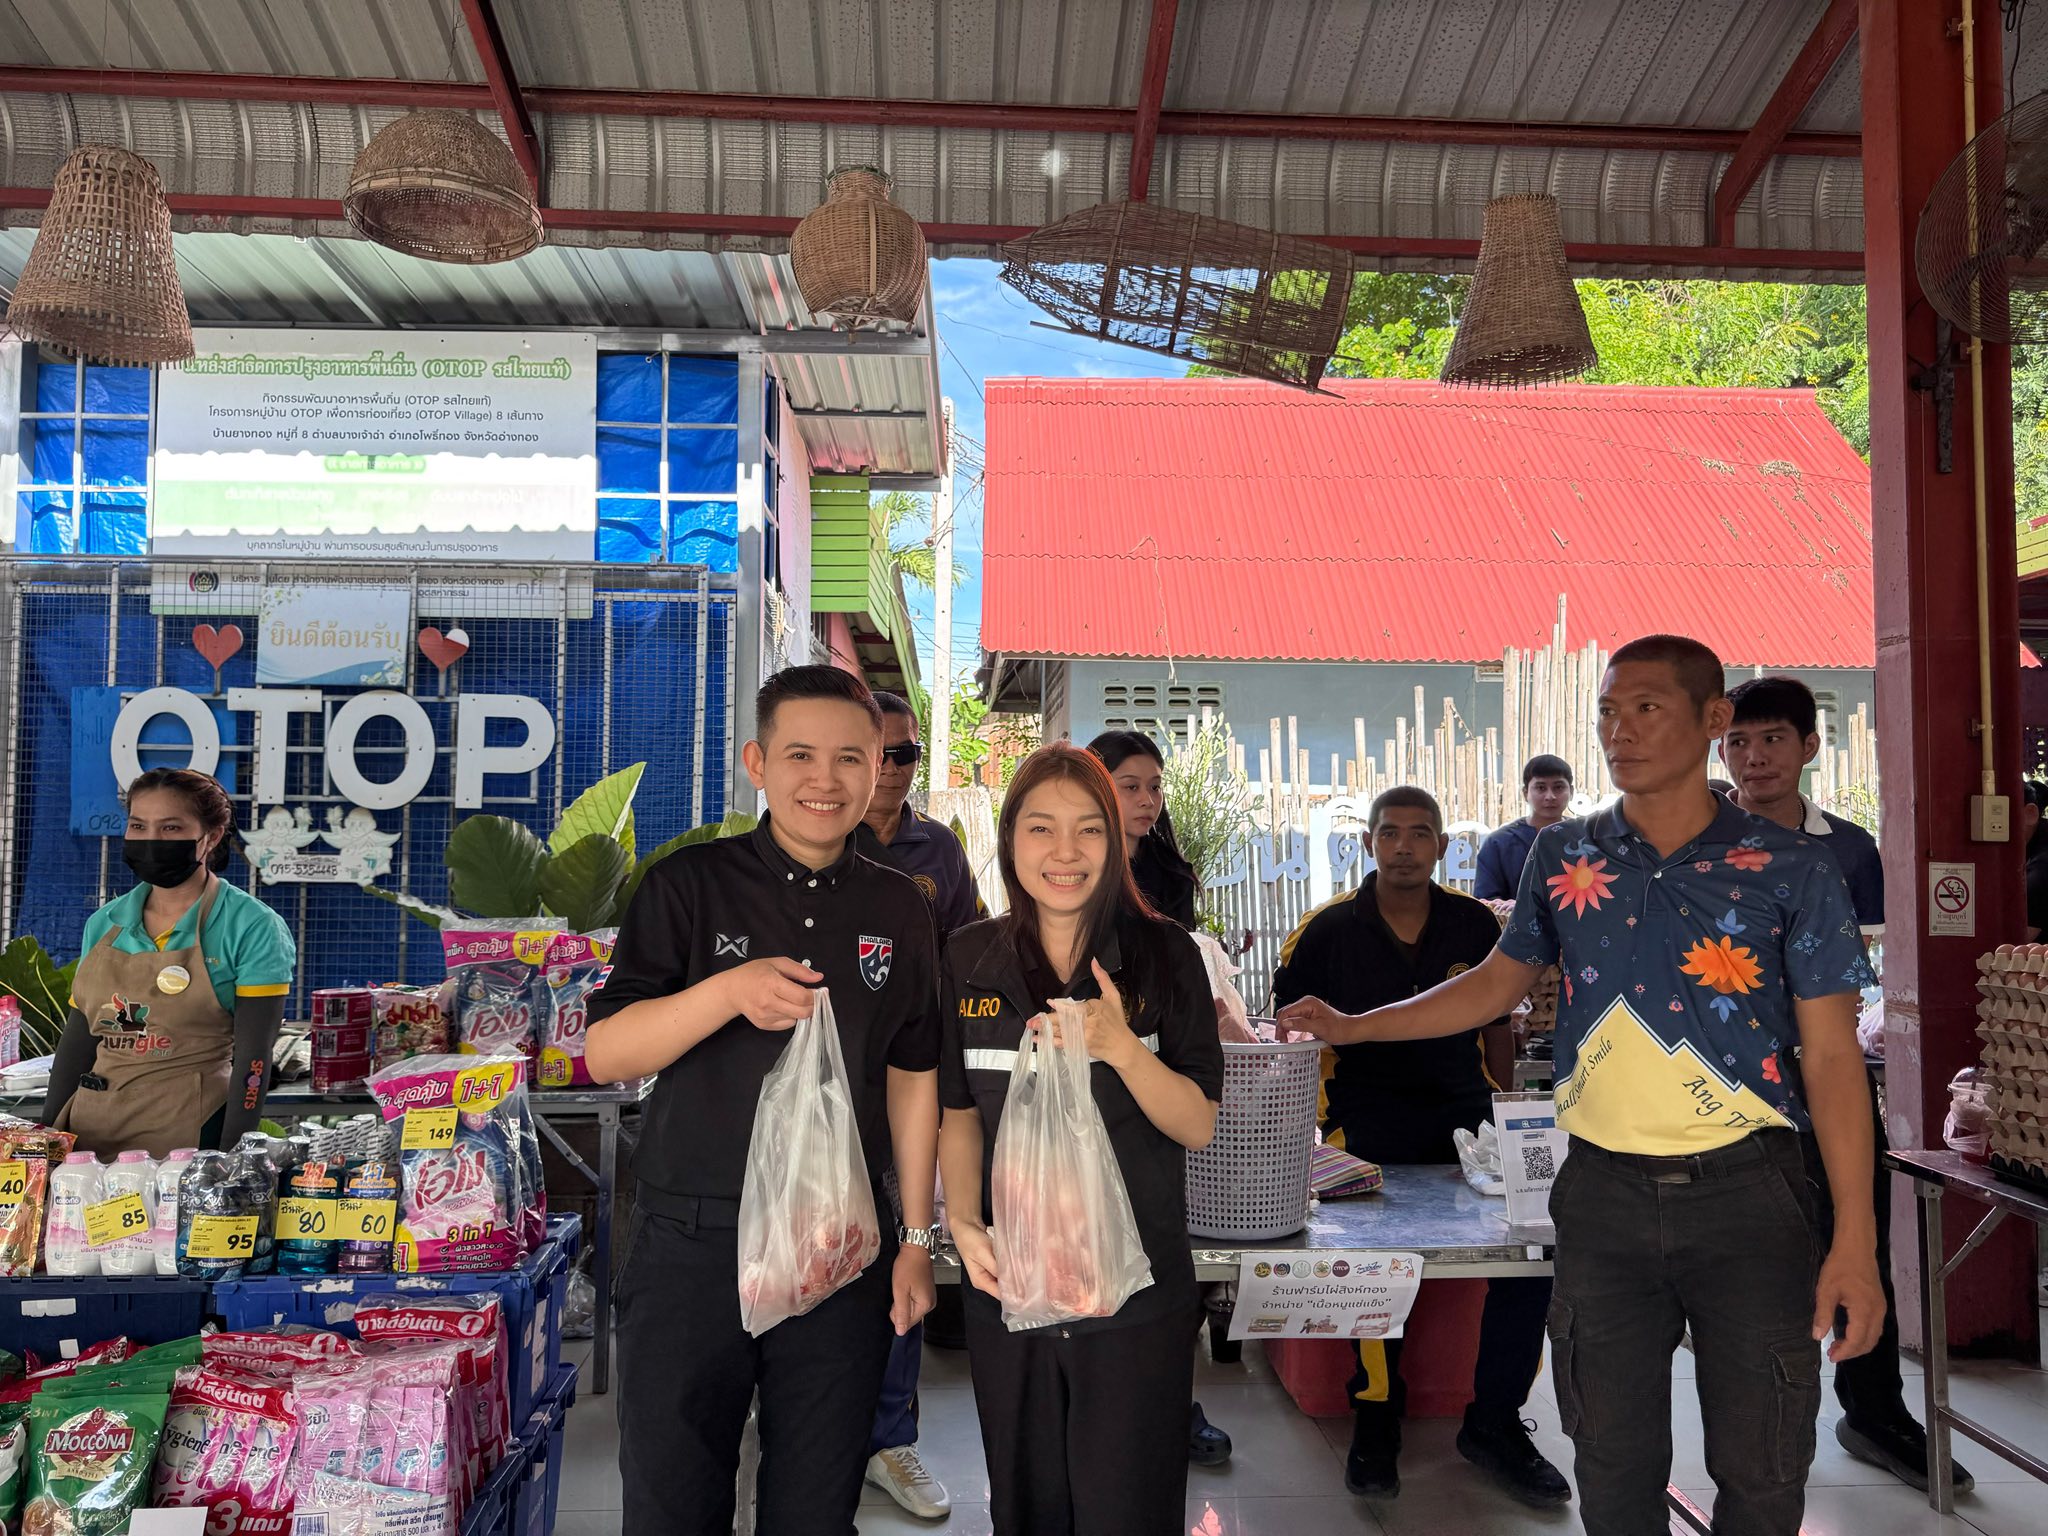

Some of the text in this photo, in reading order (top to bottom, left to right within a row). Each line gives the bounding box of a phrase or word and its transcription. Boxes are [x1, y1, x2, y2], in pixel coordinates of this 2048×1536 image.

[423, 358, 488, 379] (OTOP
[492, 355, 572, 380] รสไทยแท้)
[262, 391, 492, 407] กิจกรรมพัฒนาอาหารพื้นถิ่น (OTOP รสไทยแท้)
[209, 405, 544, 422] โครงการหมู่บ้าน OTOP เพื่อการท่องเที่ยว (OTOP Village) 8 เส้นทาง
[213, 426, 273, 439] บ้านยางทอง
[276, 426, 298, 441] หมู่ที่
[301, 430, 309, 439] 8
[389, 428, 460, 441] อำเภอโพธิ์ทอง
[464, 429, 539, 442] จังหวัดอ่างทอง
[270, 619, 401, 650] ยินดีต้อนรับ
[111, 687, 556, 811] OTOP
[466, 938, 509, 960] สุดคุ้ม
[859, 936, 893, 947] THAILAND
[958, 996, 1001, 1018] ALRO
[554, 1002, 588, 1043] โอ
[1586, 1035, 1614, 1070] Smile
[243, 1058, 264, 1110] SPORTS
[393, 1078, 449, 1109] สุดคุ้ม
[459, 1072, 505, 1104] 1+1
[1681, 1075, 1724, 1117] Ang
[429, 1128, 454, 1141] 149
[414, 1143, 487, 1211] โอโม
[121, 1208, 146, 1228] 85
[299, 1211, 326, 1234] 80
[361, 1213, 387, 1235] 60
[227, 1234, 253, 1250] 95
[448, 1224, 494, 1243] 3 in 1
[1272, 1284, 1388, 1297] ร้านฟาร์มไผ่สิงห์ทอง
[1262, 1300, 1304, 1310] จำหน่าย
[357, 1311, 445, 1333] ขายดีอันดับ
[48, 1432, 127, 1452] MOCCONA
[161, 1426, 212, 1456] ygiene
[206, 1500, 285, 1536] 3 แถม
[408, 1527, 420, 1536] 500
